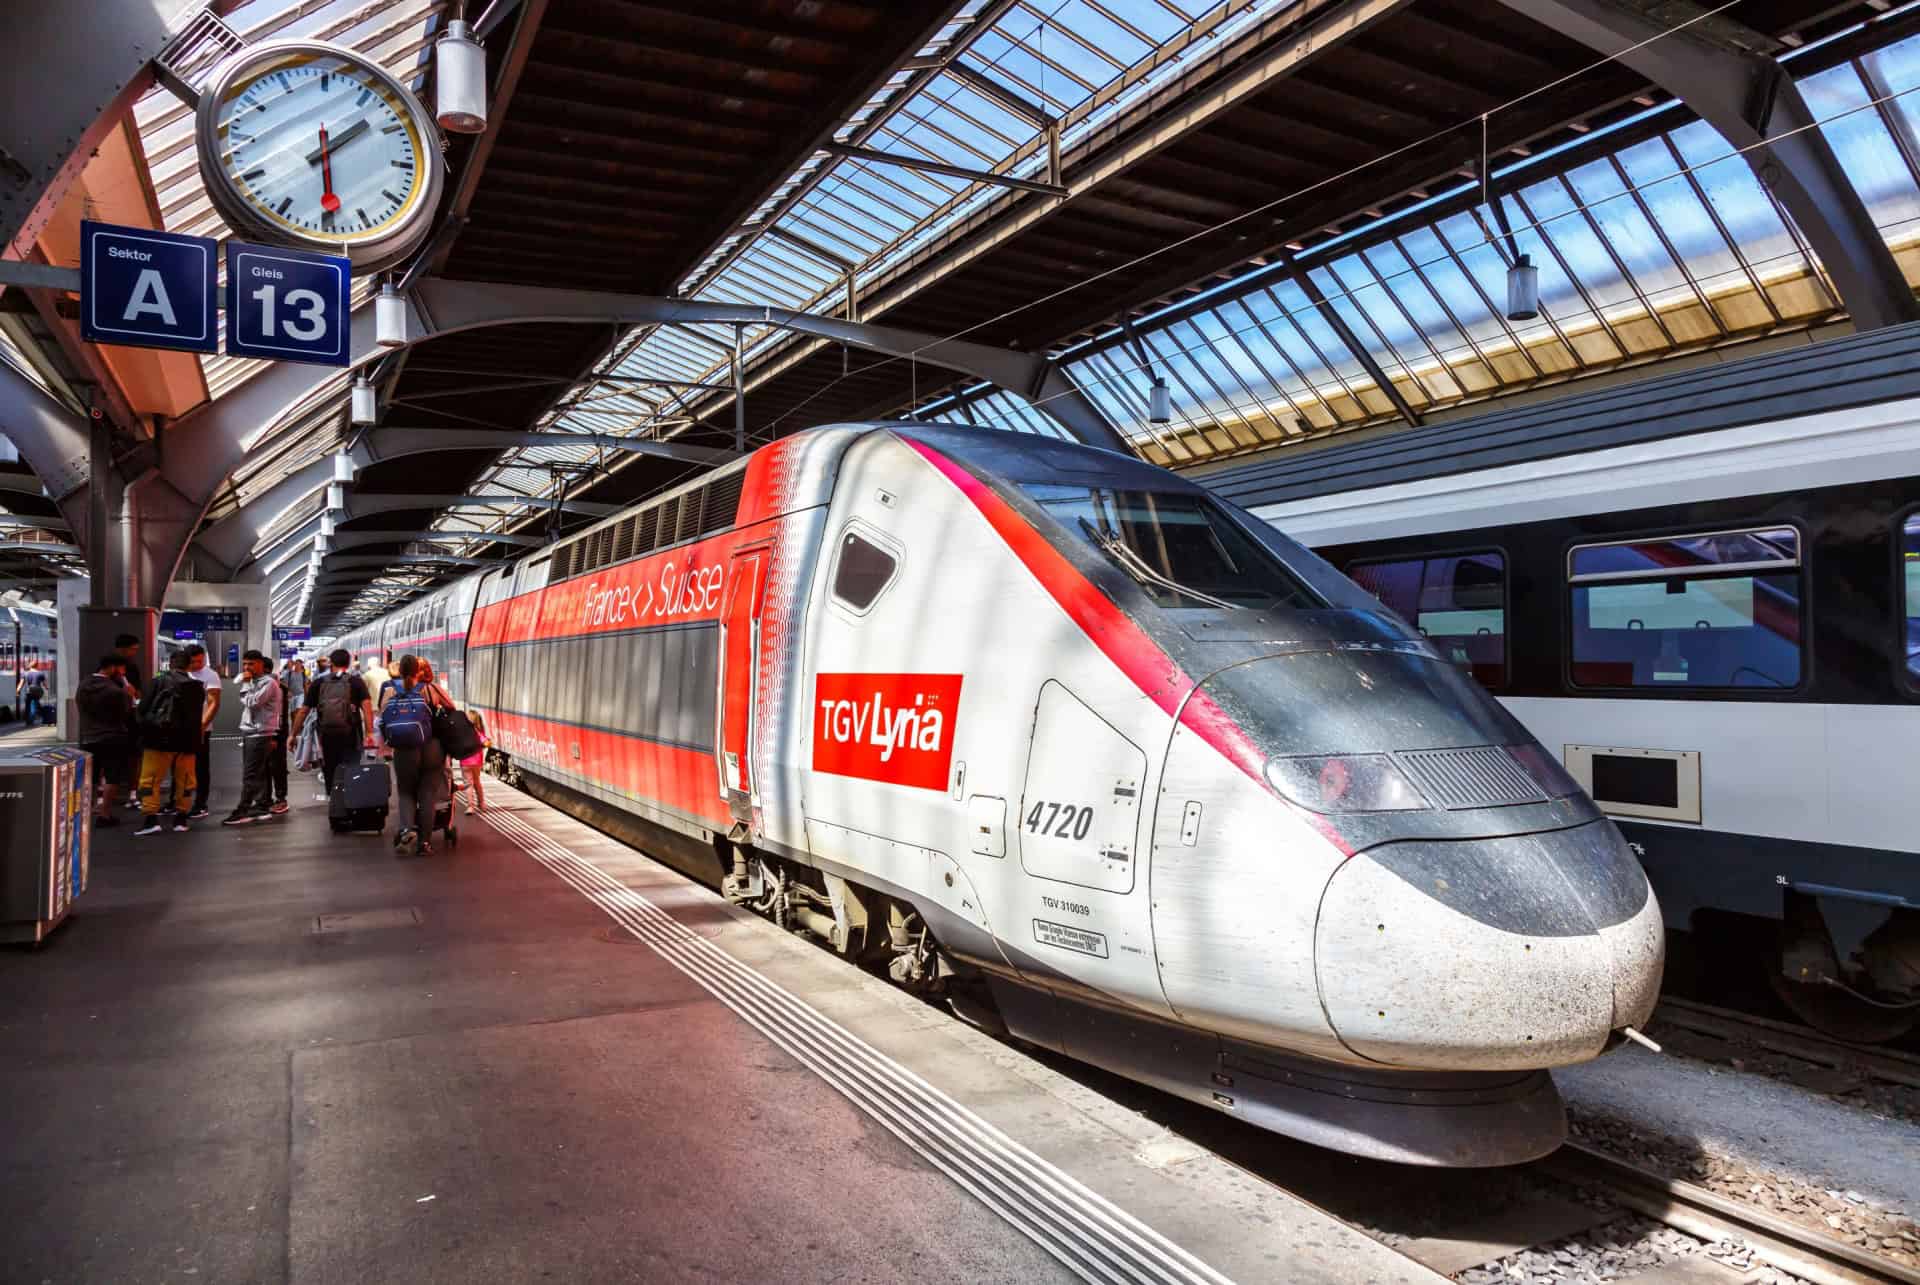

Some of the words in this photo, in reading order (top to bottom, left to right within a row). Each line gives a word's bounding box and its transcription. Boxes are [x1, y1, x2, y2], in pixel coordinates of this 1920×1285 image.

[108, 246, 152, 262] Sektor
[252, 266, 284, 280] Gleis
[123, 268, 177, 326] A
[252, 284, 328, 341] 13
[583, 582, 631, 626] France
[655, 555, 723, 616] Suisse
[821, 700, 871, 743] TGV
[870, 692, 943, 762] Lyria
[1026, 800, 1094, 841] 4720
[1776, 874, 1790, 885] 3L
[1042, 896, 1059, 909] TGV
[1061, 900, 1090, 915] 310039
